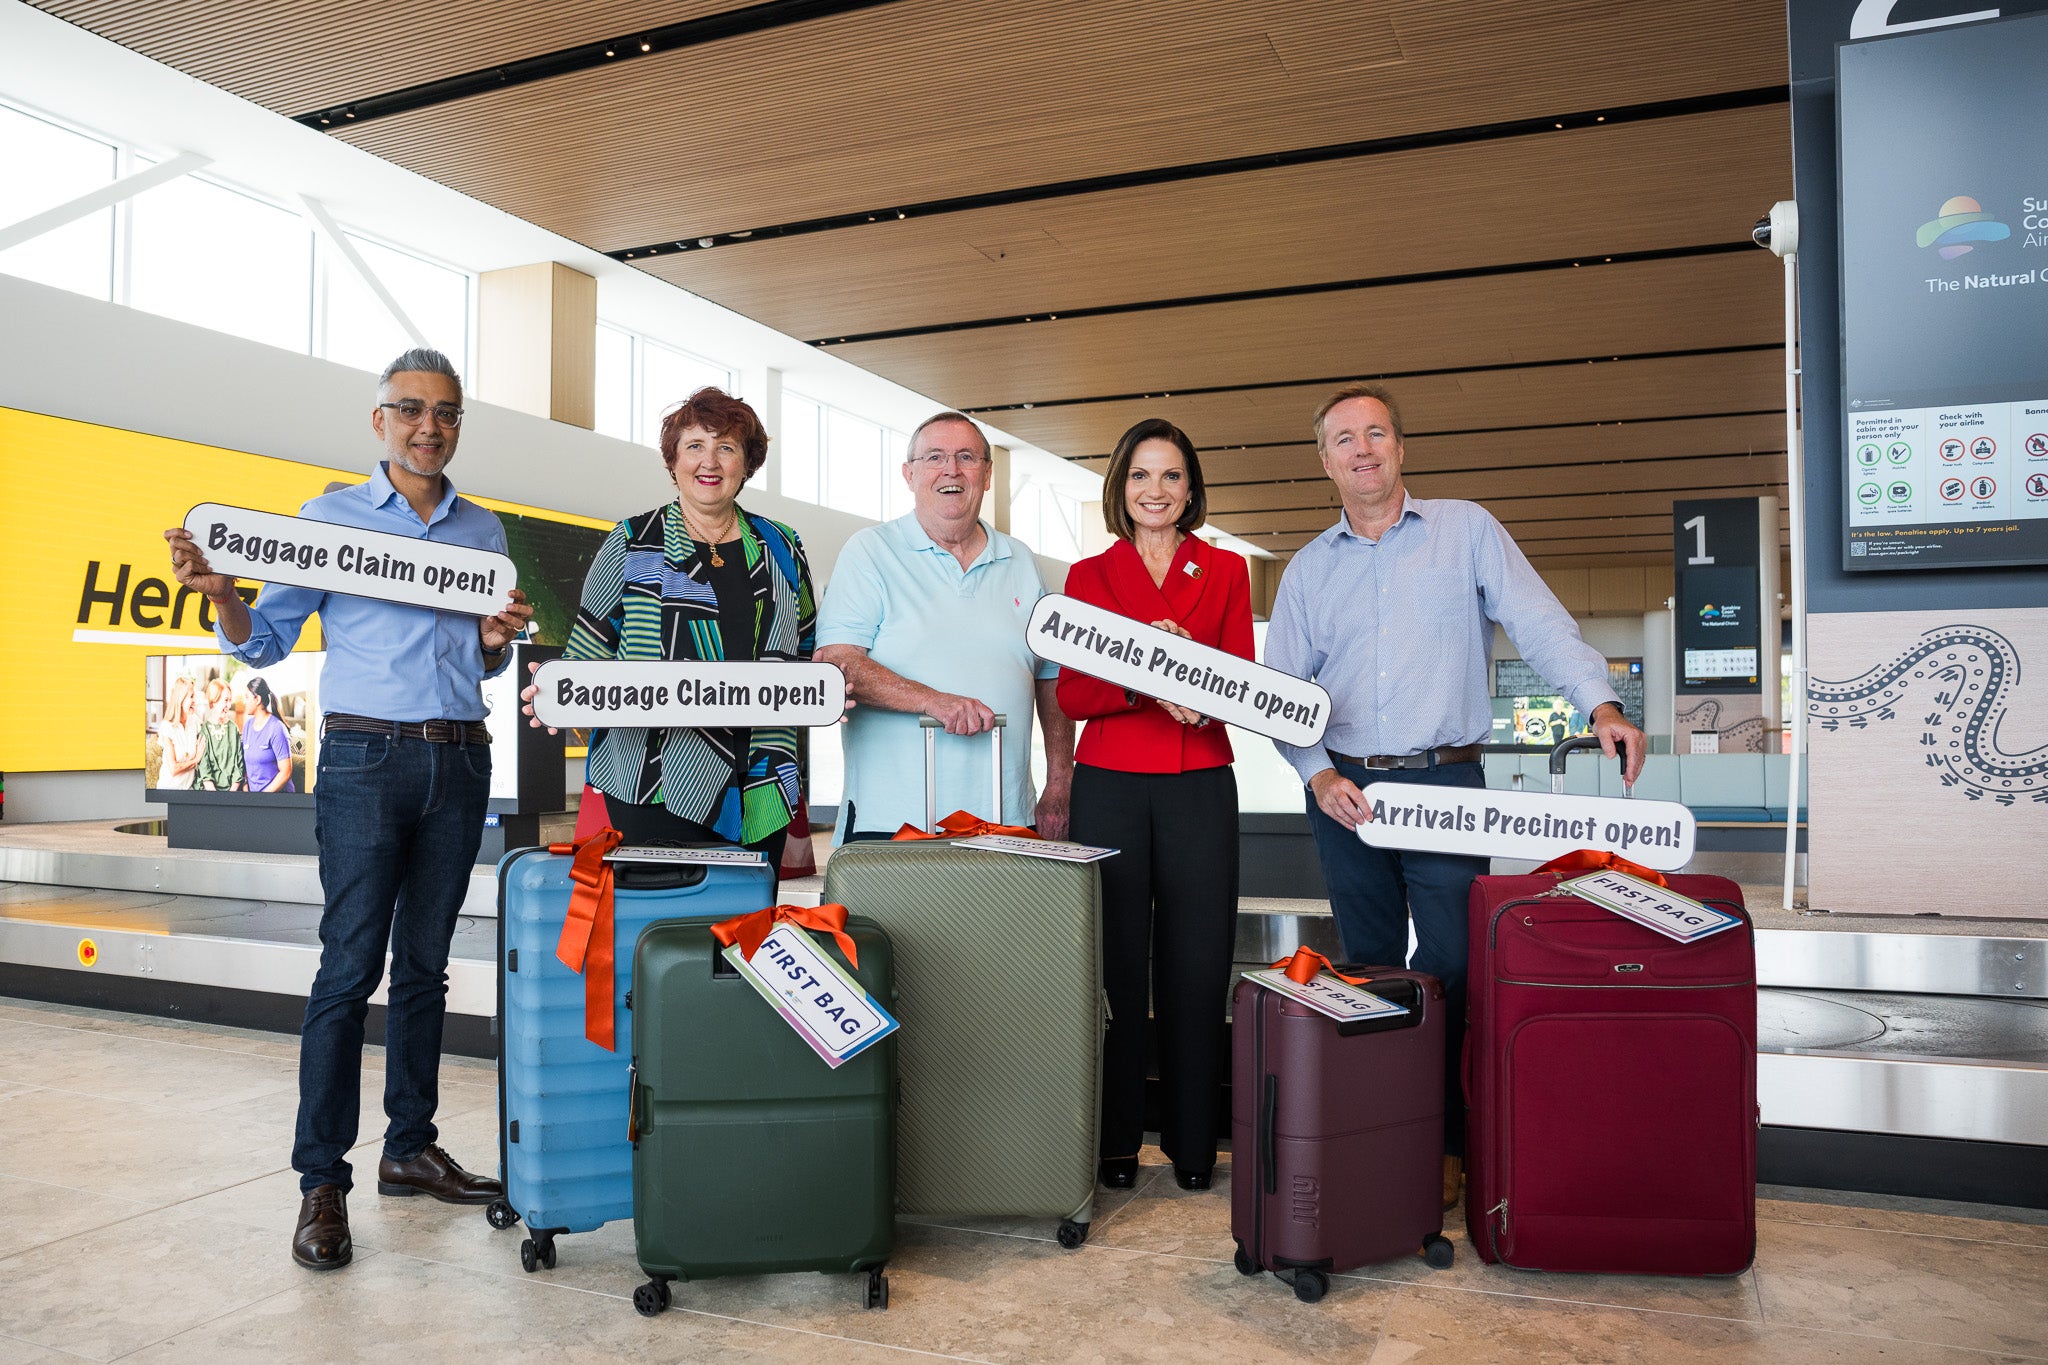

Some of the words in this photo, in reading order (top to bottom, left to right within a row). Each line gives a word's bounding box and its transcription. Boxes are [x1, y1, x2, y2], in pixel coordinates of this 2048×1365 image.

[1925, 278, 1960, 292] The
[1964, 270, 2035, 290] Natural
[1856, 418, 1893, 426] Permitted
[1940, 413, 1962, 421] Check
[1684, 516, 1715, 565] 1
[2005, 524, 2020, 532] jail.
[208, 522, 328, 570] Baggage
[337, 544, 416, 582] Claim
[423, 568, 496, 596] open!
[1040, 610, 1144, 667] Arrivals
[1148, 646, 1250, 704] Precinct
[1254, 690, 1320, 730] open!
[557, 678, 668, 712] Baggage
[676, 679, 750, 706] Claim
[758, 680, 825, 712] open!
[1371, 799, 1476, 832] Arrivals
[1484, 808, 1597, 841] Precinct
[1604, 820, 1682, 850] open!
[1593, 877, 1656, 904] FIRST
[1654, 903, 1704, 926] BAG
[760, 938, 820, 990] FIRST
[814, 992, 860, 1035] BAG
[1328, 990, 1371, 1010] BAG
